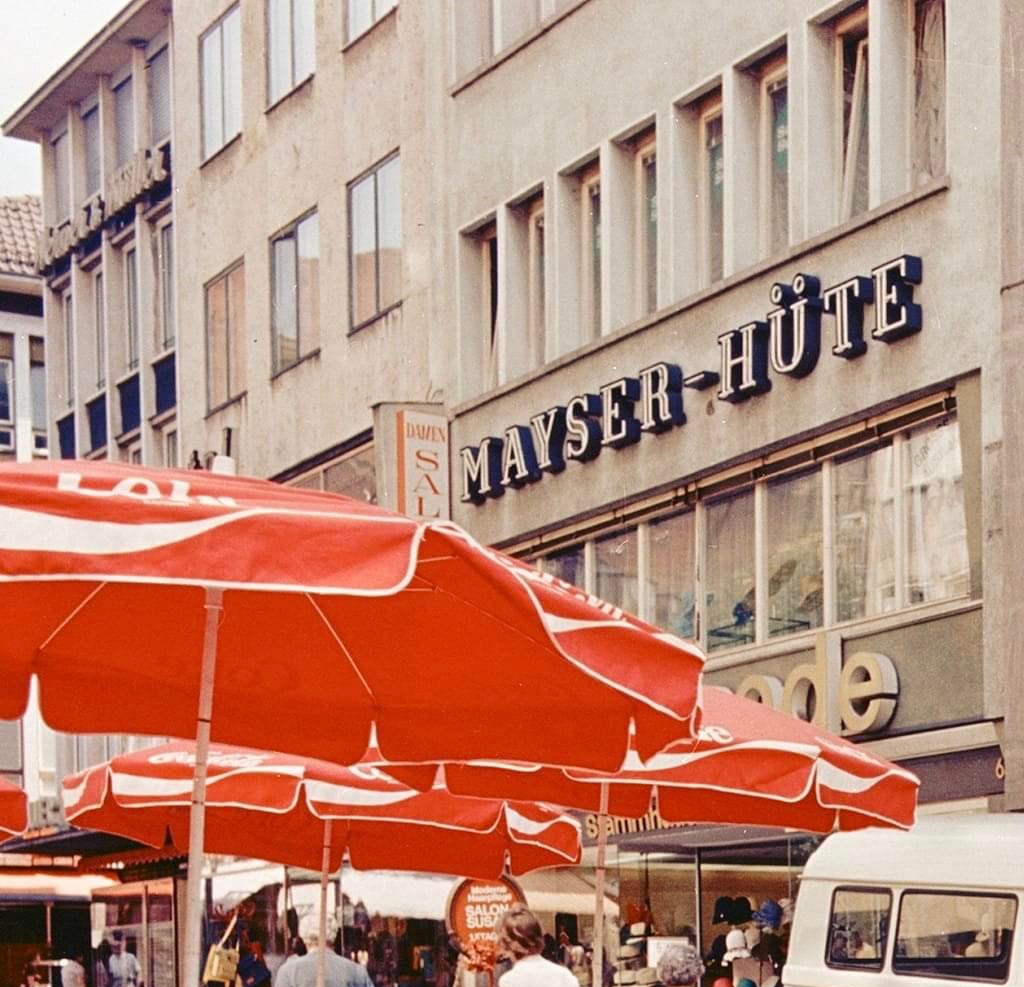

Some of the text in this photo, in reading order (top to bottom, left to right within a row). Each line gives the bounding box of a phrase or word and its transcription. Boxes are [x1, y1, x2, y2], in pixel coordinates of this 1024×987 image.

[460, 254, 922, 504] MAYSER-HÜTE
[406, 421, 447, 444] DAMEN
[465, 903, 509, 916] SALON
